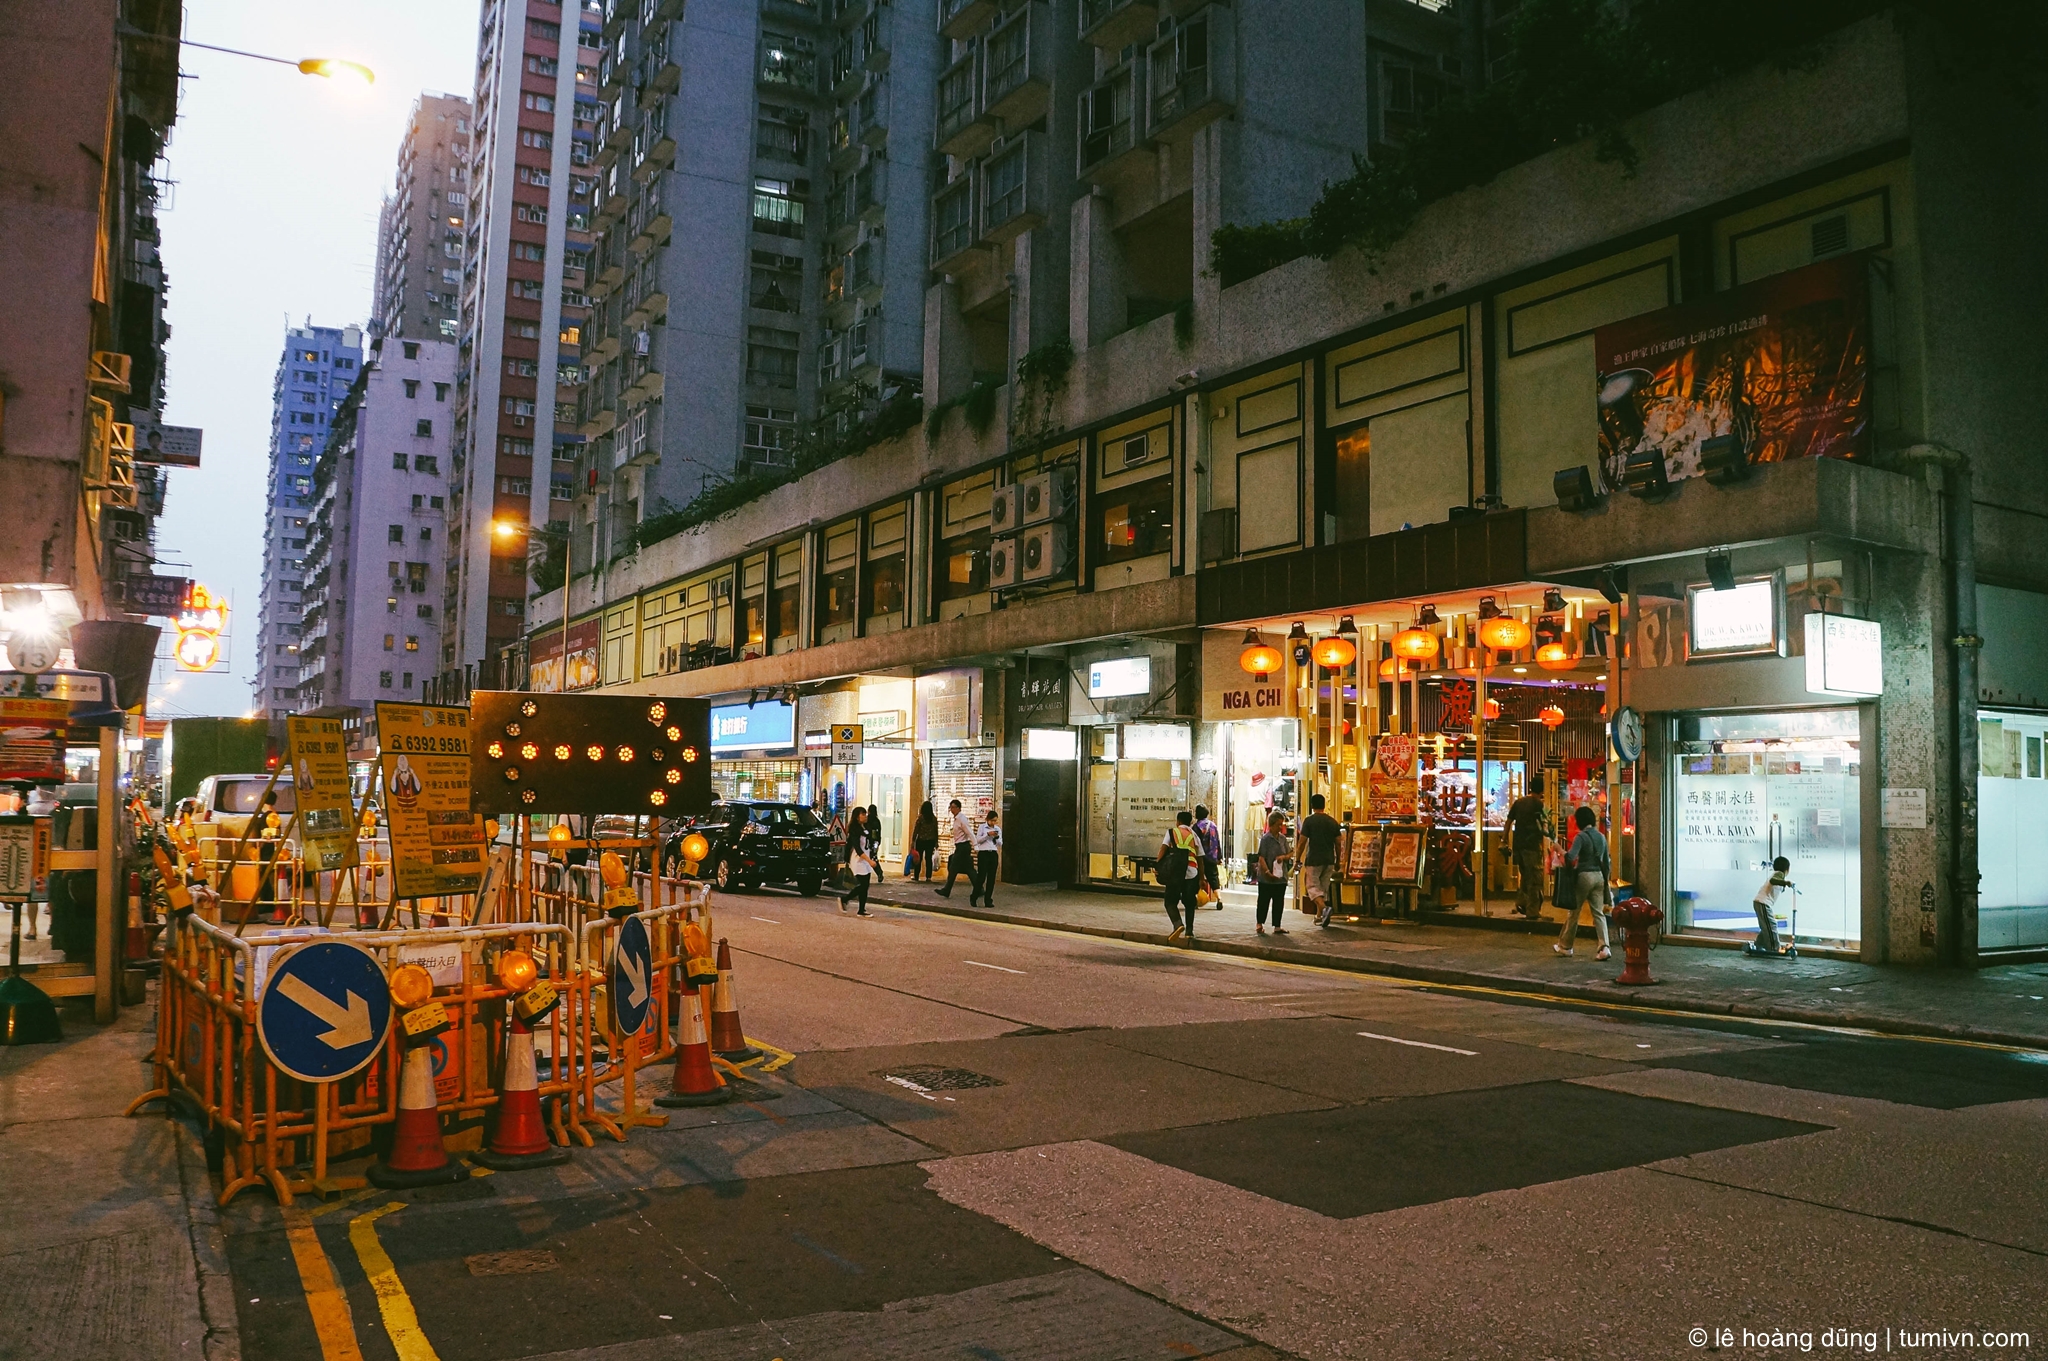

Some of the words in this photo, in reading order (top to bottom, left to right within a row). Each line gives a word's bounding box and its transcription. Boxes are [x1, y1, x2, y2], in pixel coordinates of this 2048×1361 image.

[1223, 690, 1251, 709] NGA
[1256, 688, 1281, 706] CHI
[405, 735, 437, 751] 6392
[439, 736, 468, 753] 9581
[837, 752, 858, 762] 終止
[1687, 790, 1756, 806] 西醫關永佳
[1688, 824, 1703, 836] DR.
[1704, 825, 1715, 836] W.
[1717, 825, 1726, 837] K.
[1728, 825, 1756, 837] KWAN
